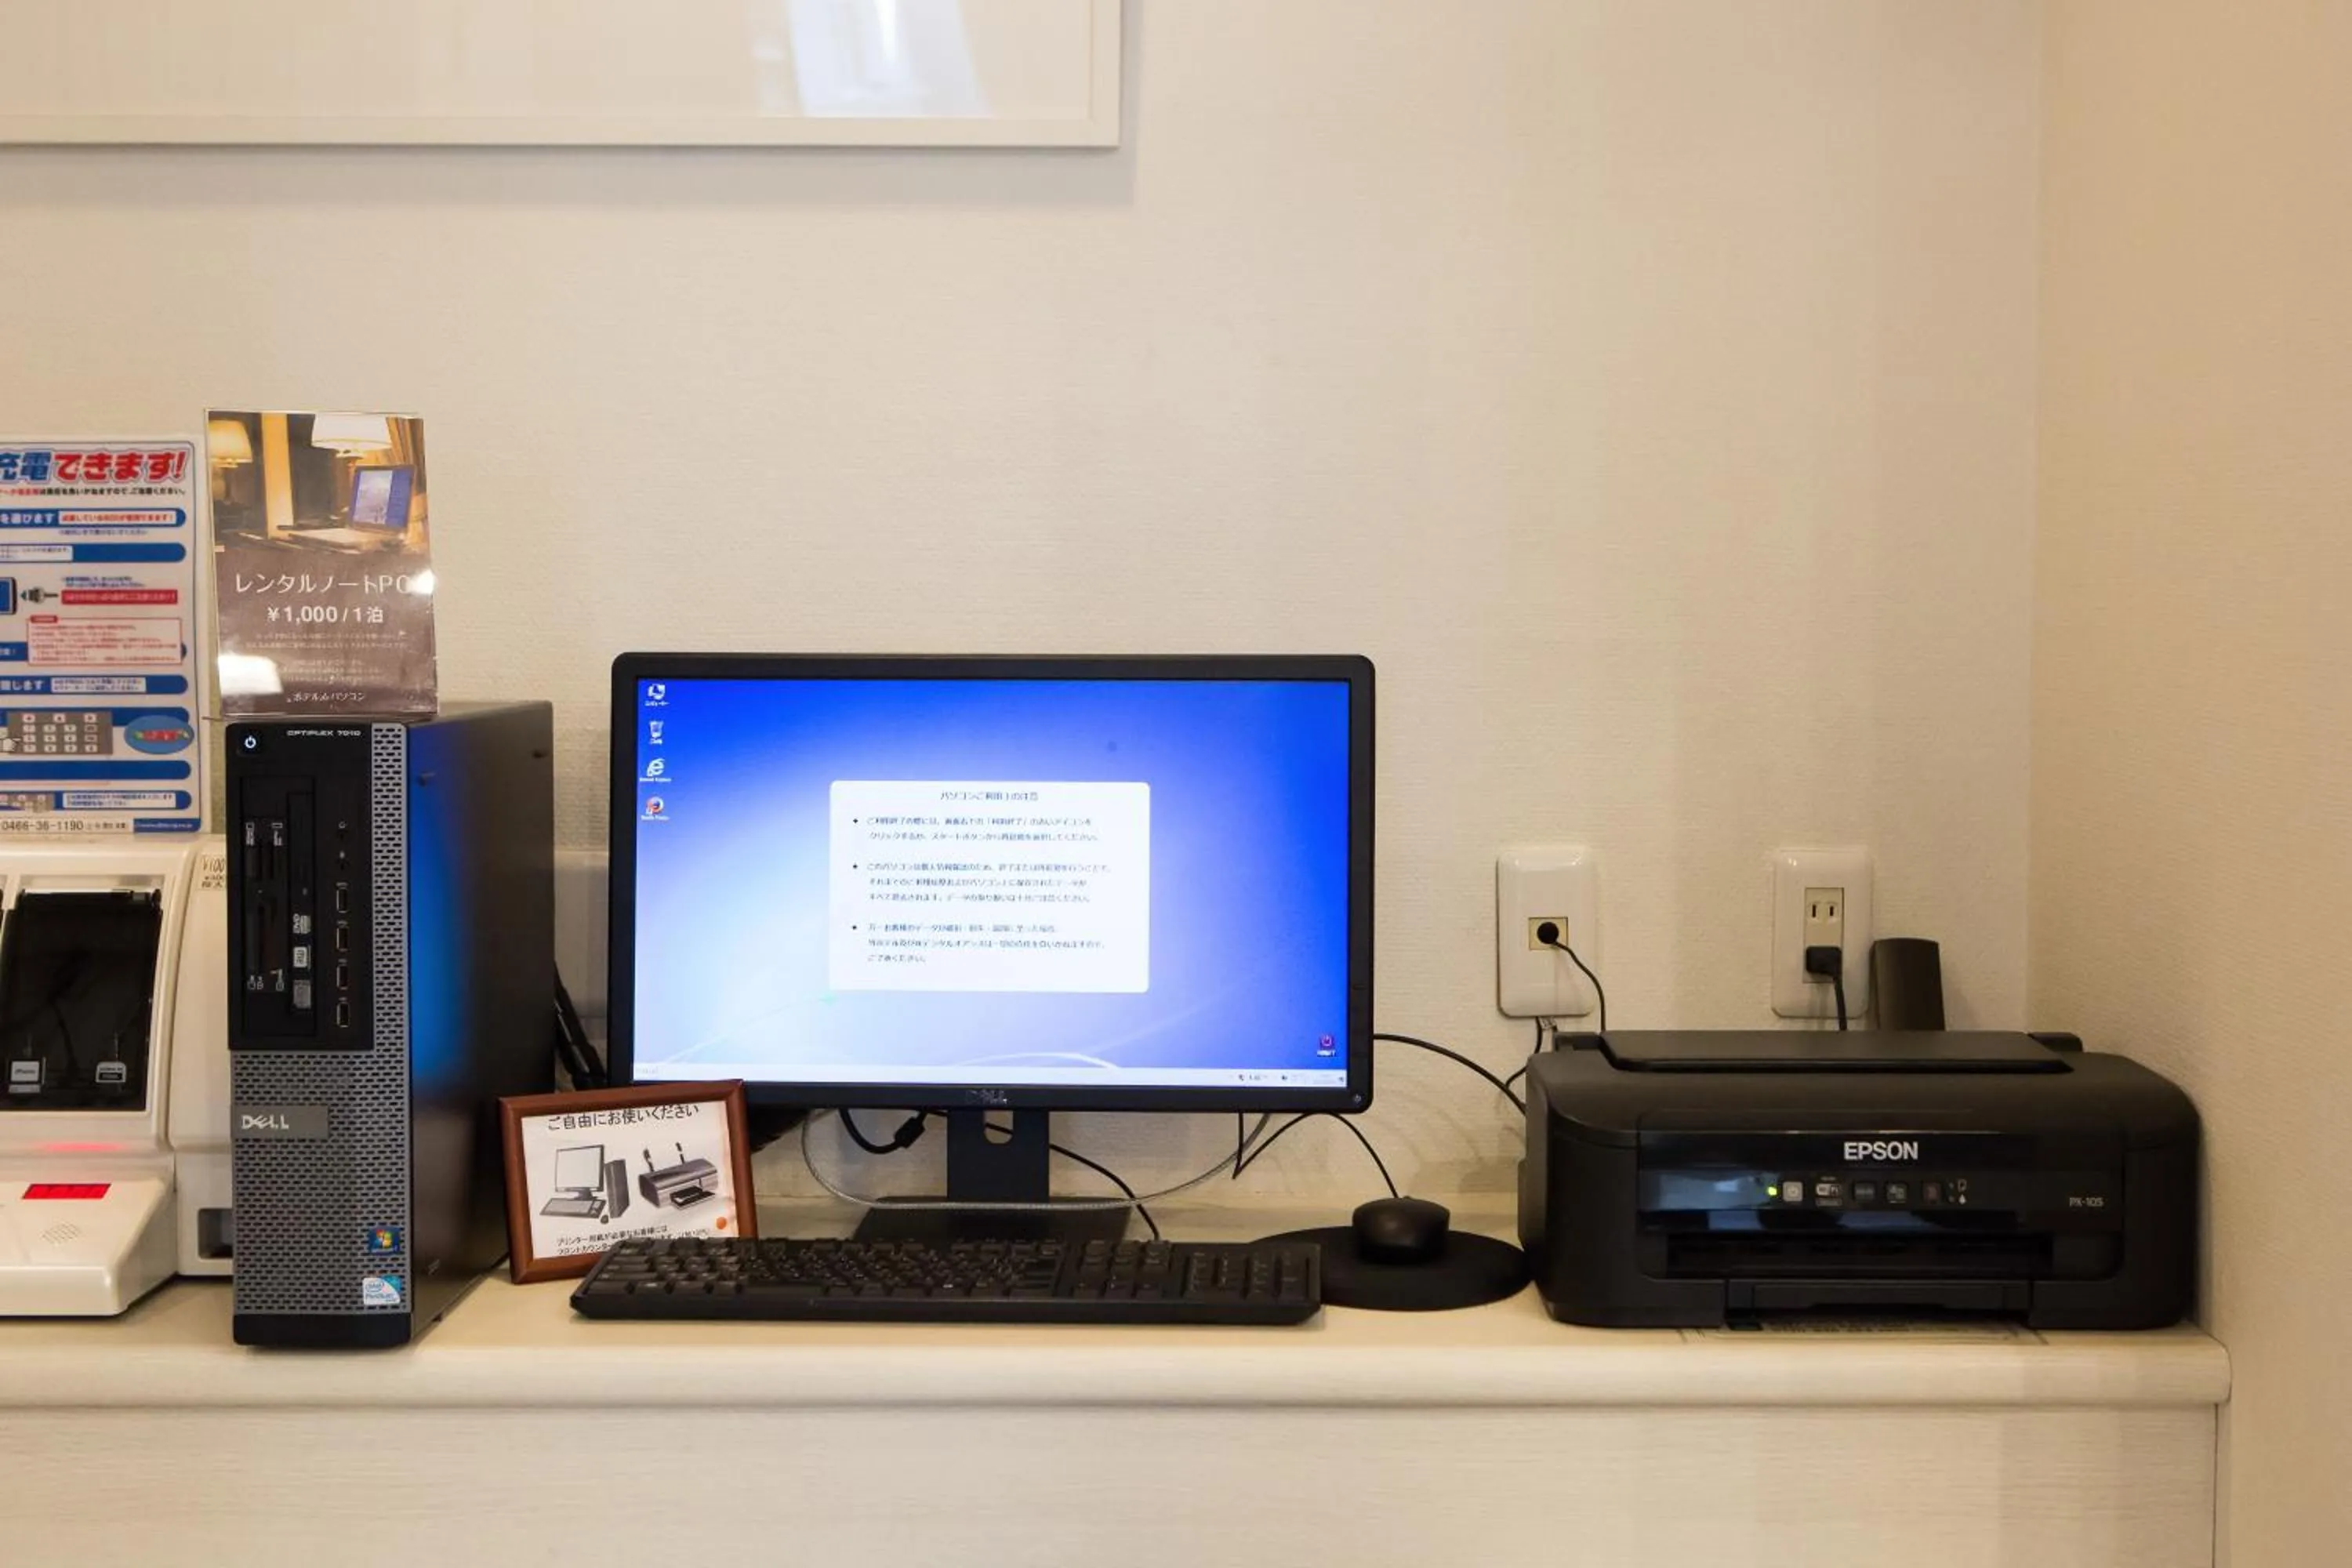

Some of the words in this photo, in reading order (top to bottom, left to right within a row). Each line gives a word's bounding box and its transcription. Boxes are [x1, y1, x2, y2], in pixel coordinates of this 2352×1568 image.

[241, 1115, 289, 1130] DELL
[548, 1103, 699, 1131] ご自由にお使いください
[1844, 1142, 1918, 1160] EPSON
